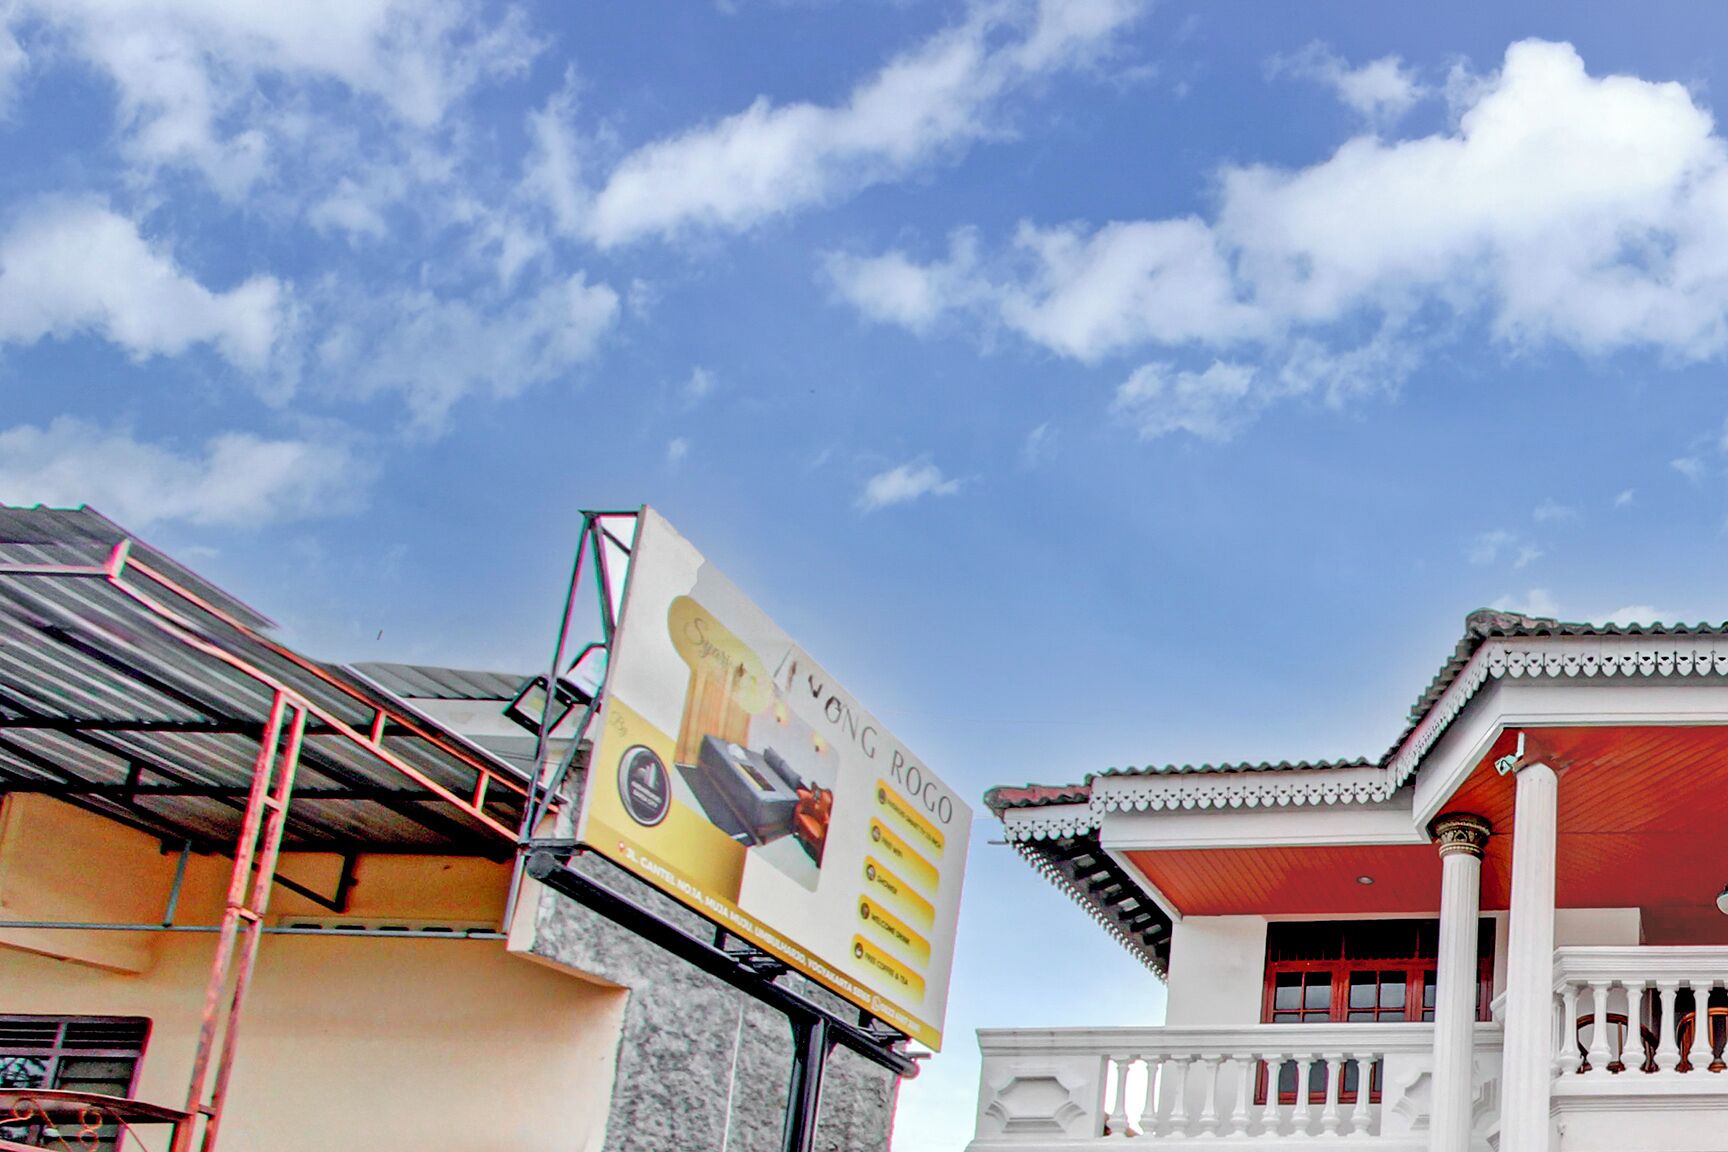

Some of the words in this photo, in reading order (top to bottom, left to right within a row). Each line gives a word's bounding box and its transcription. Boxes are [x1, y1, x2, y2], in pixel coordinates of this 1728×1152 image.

[891, 750, 953, 824] ROGO
[640, 857, 677, 886] CANTEL
[877, 875, 897, 895] SHOWER
[871, 912, 895, 935] WELCOME
[876, 960, 896, 978] COFFEE
